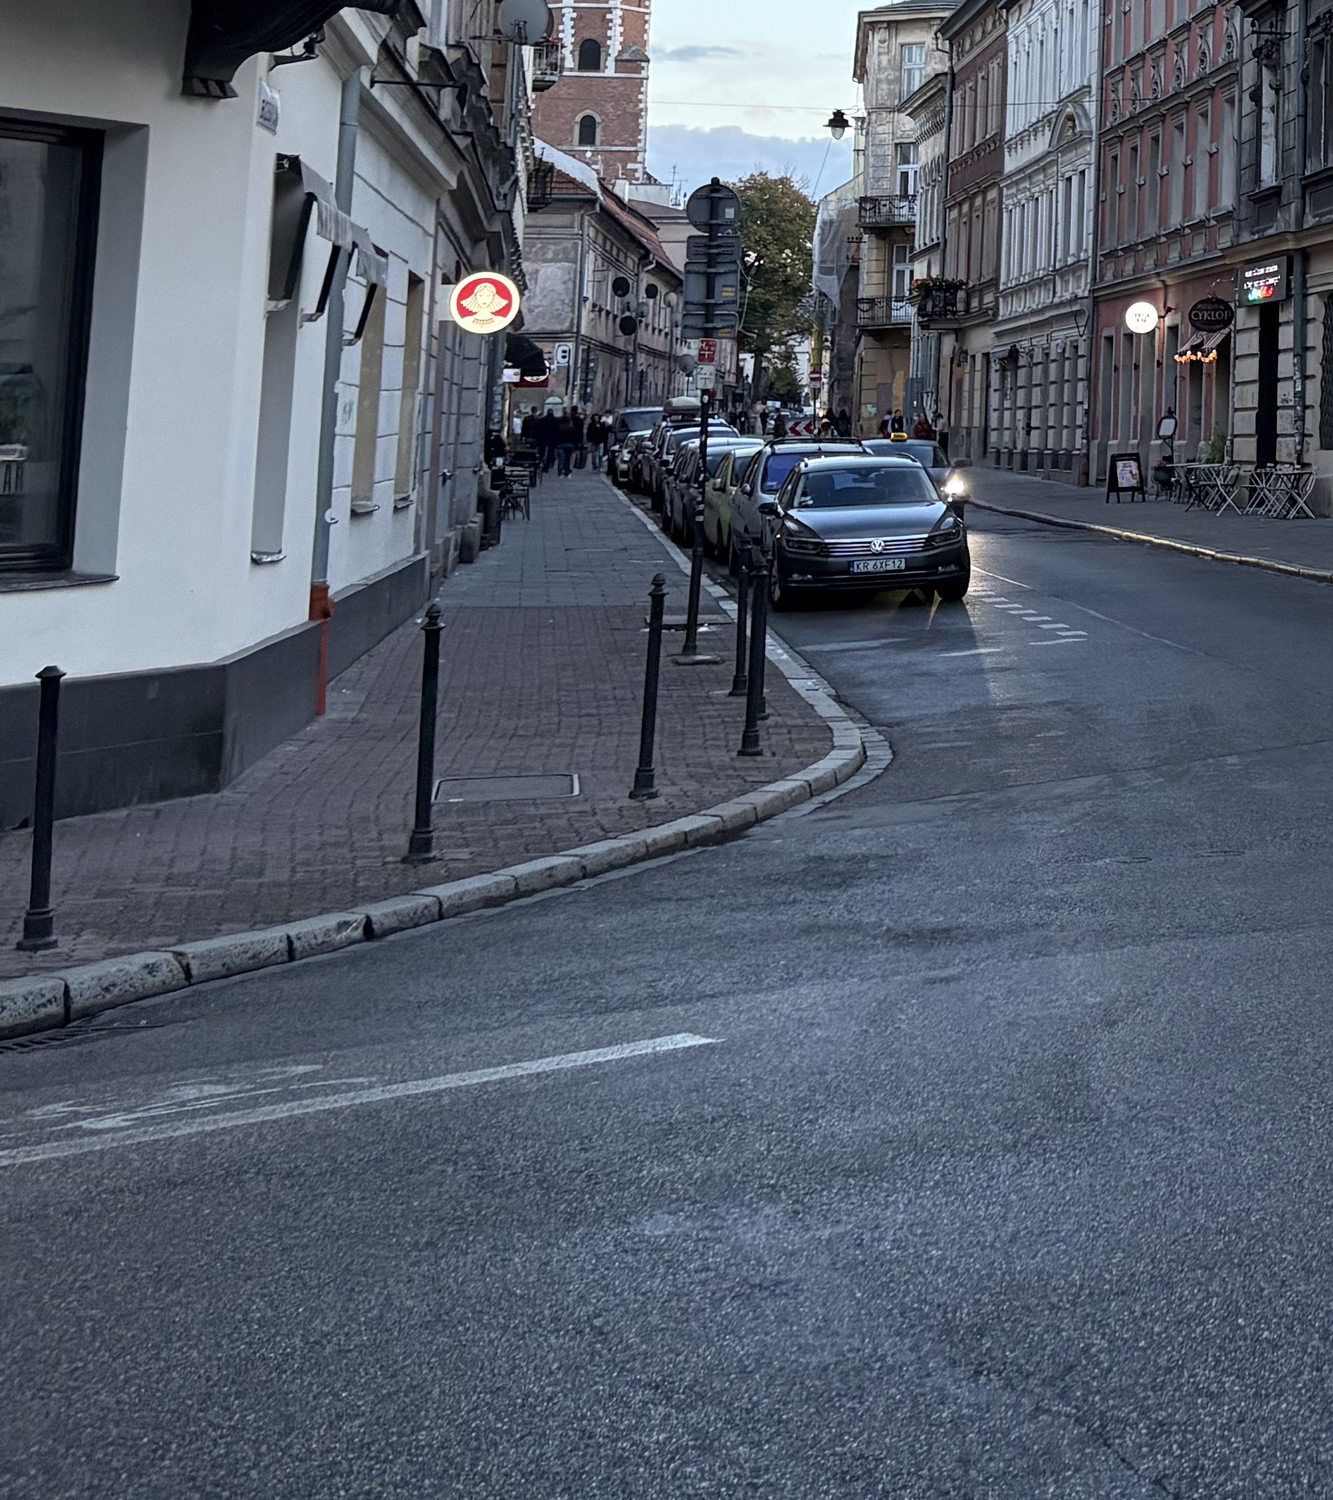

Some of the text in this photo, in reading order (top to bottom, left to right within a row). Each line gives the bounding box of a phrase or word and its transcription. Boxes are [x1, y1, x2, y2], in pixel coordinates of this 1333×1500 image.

[1191, 310, 1232, 321] CYKLOP
[856, 560, 903, 572] KR 6XF12
